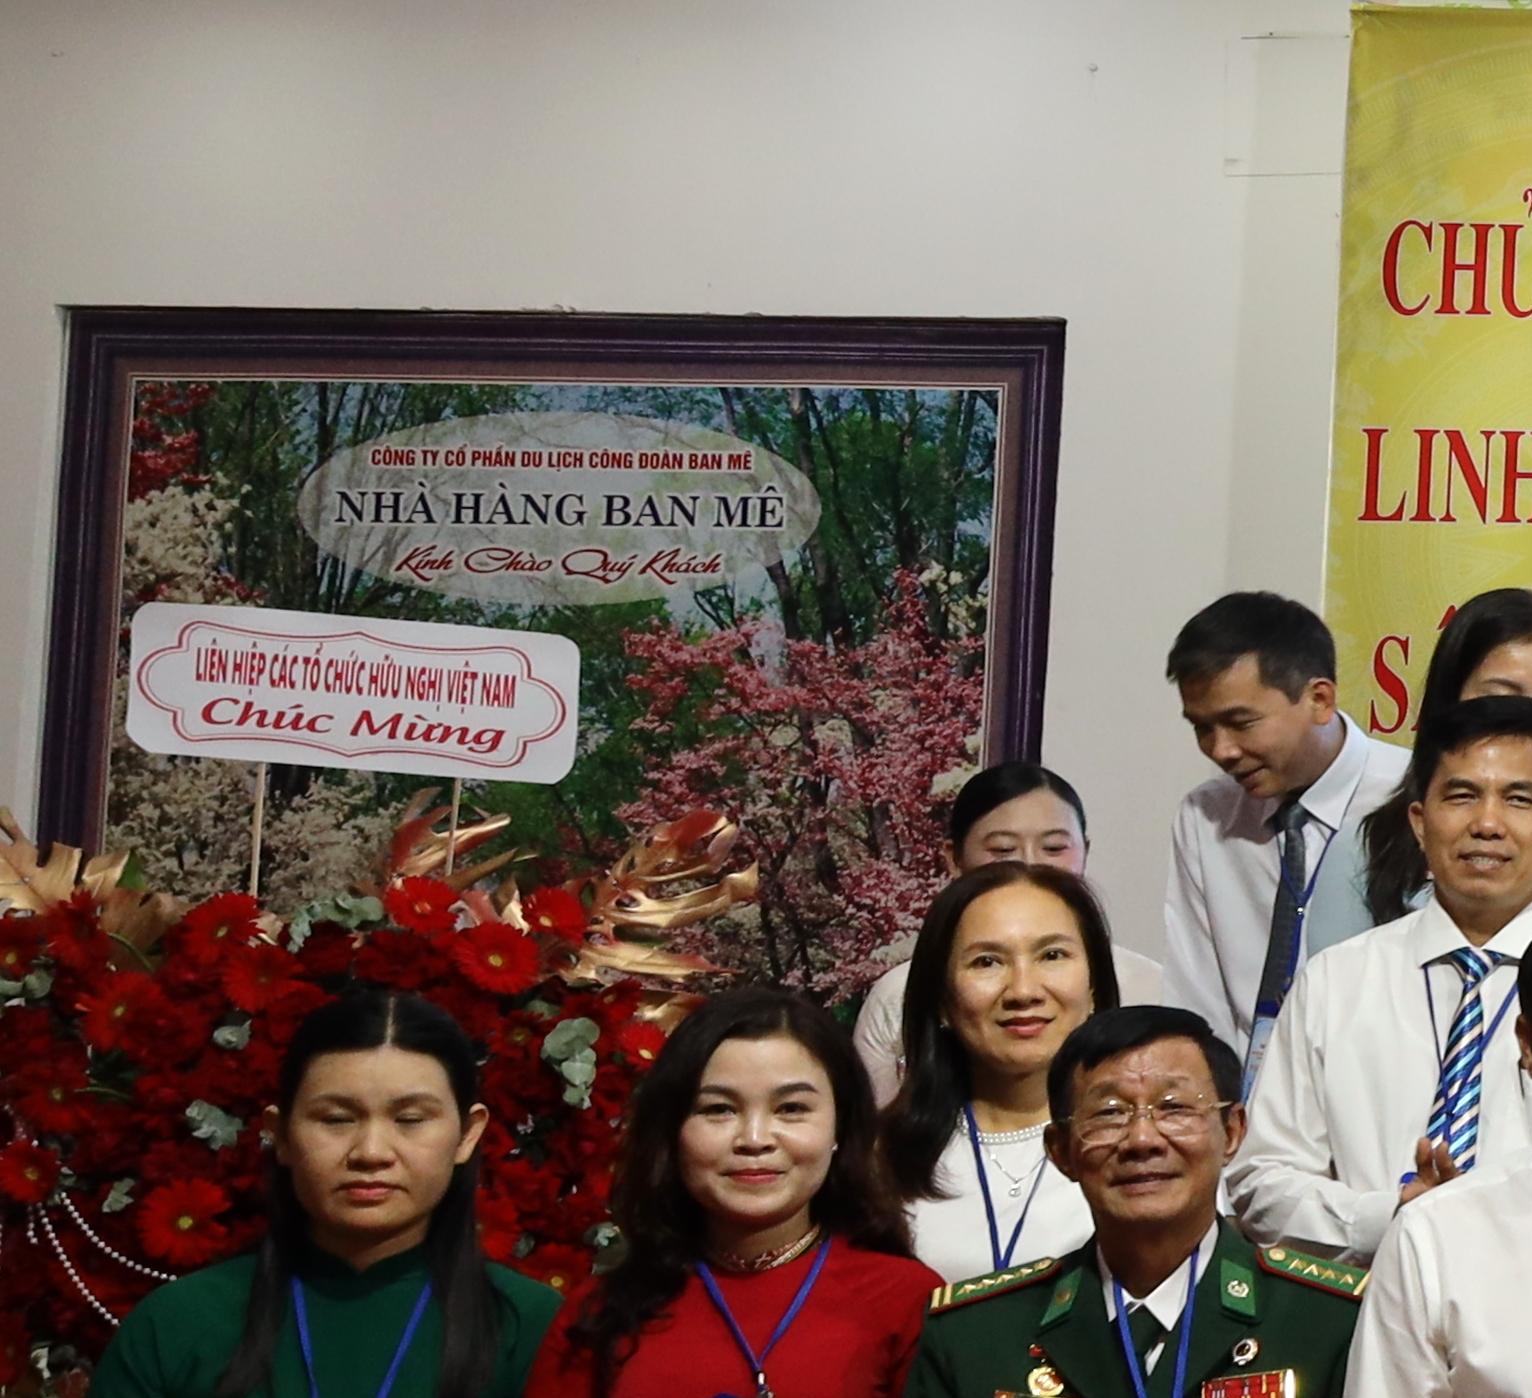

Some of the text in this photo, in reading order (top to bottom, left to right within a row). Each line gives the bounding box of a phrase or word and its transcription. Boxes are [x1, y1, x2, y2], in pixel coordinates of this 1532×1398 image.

[371, 447, 415, 466] CÔNG
[422, 450, 440, 466] TY
[521, 451, 544, 468] DU
[548, 452, 583, 473] LỊCH
[588, 449, 635, 470] CÔNG
[638, 447, 685, 471] ĐOÀN
[689, 453, 722, 471] BAN
[727, 451, 753, 471] MÊ
[334, 481, 786, 528] NHÀ HÀNG BAN MÊ
[396, 545, 721, 585] Kính Chào Quý Khách
[195, 638, 516, 714] LIÊN HIỆP CÁC TỔ CHỨC HỮU NGHỊ VIỆT NAM
[201, 697, 506, 753] Chúc Mừng
